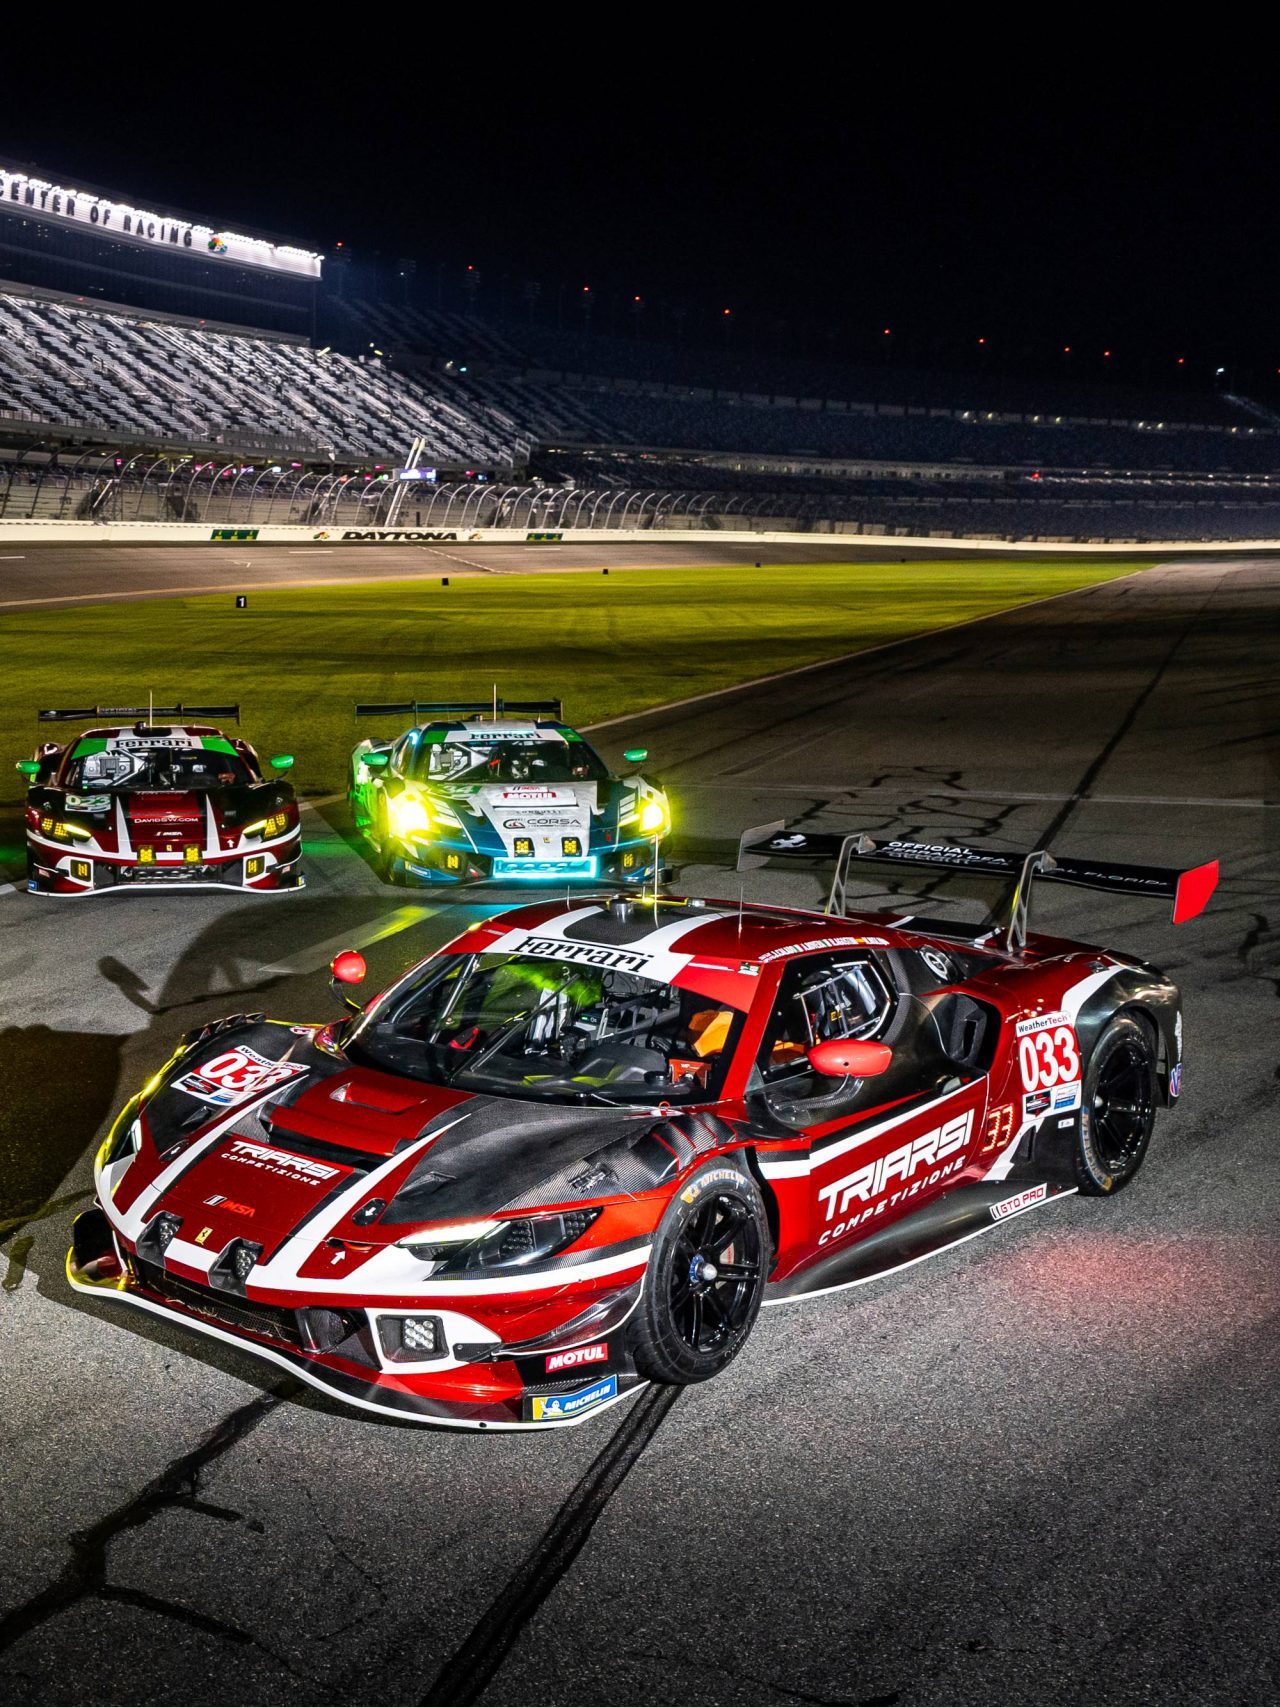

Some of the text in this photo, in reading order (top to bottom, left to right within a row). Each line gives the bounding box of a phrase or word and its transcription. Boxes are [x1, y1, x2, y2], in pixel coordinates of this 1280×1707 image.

[89, 205, 111, 226] OF
[123, 214, 193, 247] RACING
[341, 531, 458, 541] DAYTONA
[237, 596, 246, 608] 1
[114, 737, 193, 748] Ferrari
[470, 731, 543, 740] Ferrari
[888, 841, 973, 855] OFFICIAL
[508, 936, 655, 973] Ferrari
[1018, 1014, 1069, 1033] WeatherTech
[199, 1052, 293, 1092] 033
[1019, 1026, 1080, 1092] 033
[982, 1104, 1014, 1152] 33
[221, 1153, 321, 1187] COMPETIZIONE
[230, 1140, 341, 1180] TRIARSI
[818, 1108, 975, 1222] TRIARSI
[220, 1201, 256, 1218] IMSA
[817, 1154, 967, 1246] COMPETIZIONE
[999, 1188, 1044, 1214] GTD PRO
[548, 1346, 605, 1369] MOTUL
[564, 1384, 611, 1412] MICHELIN
